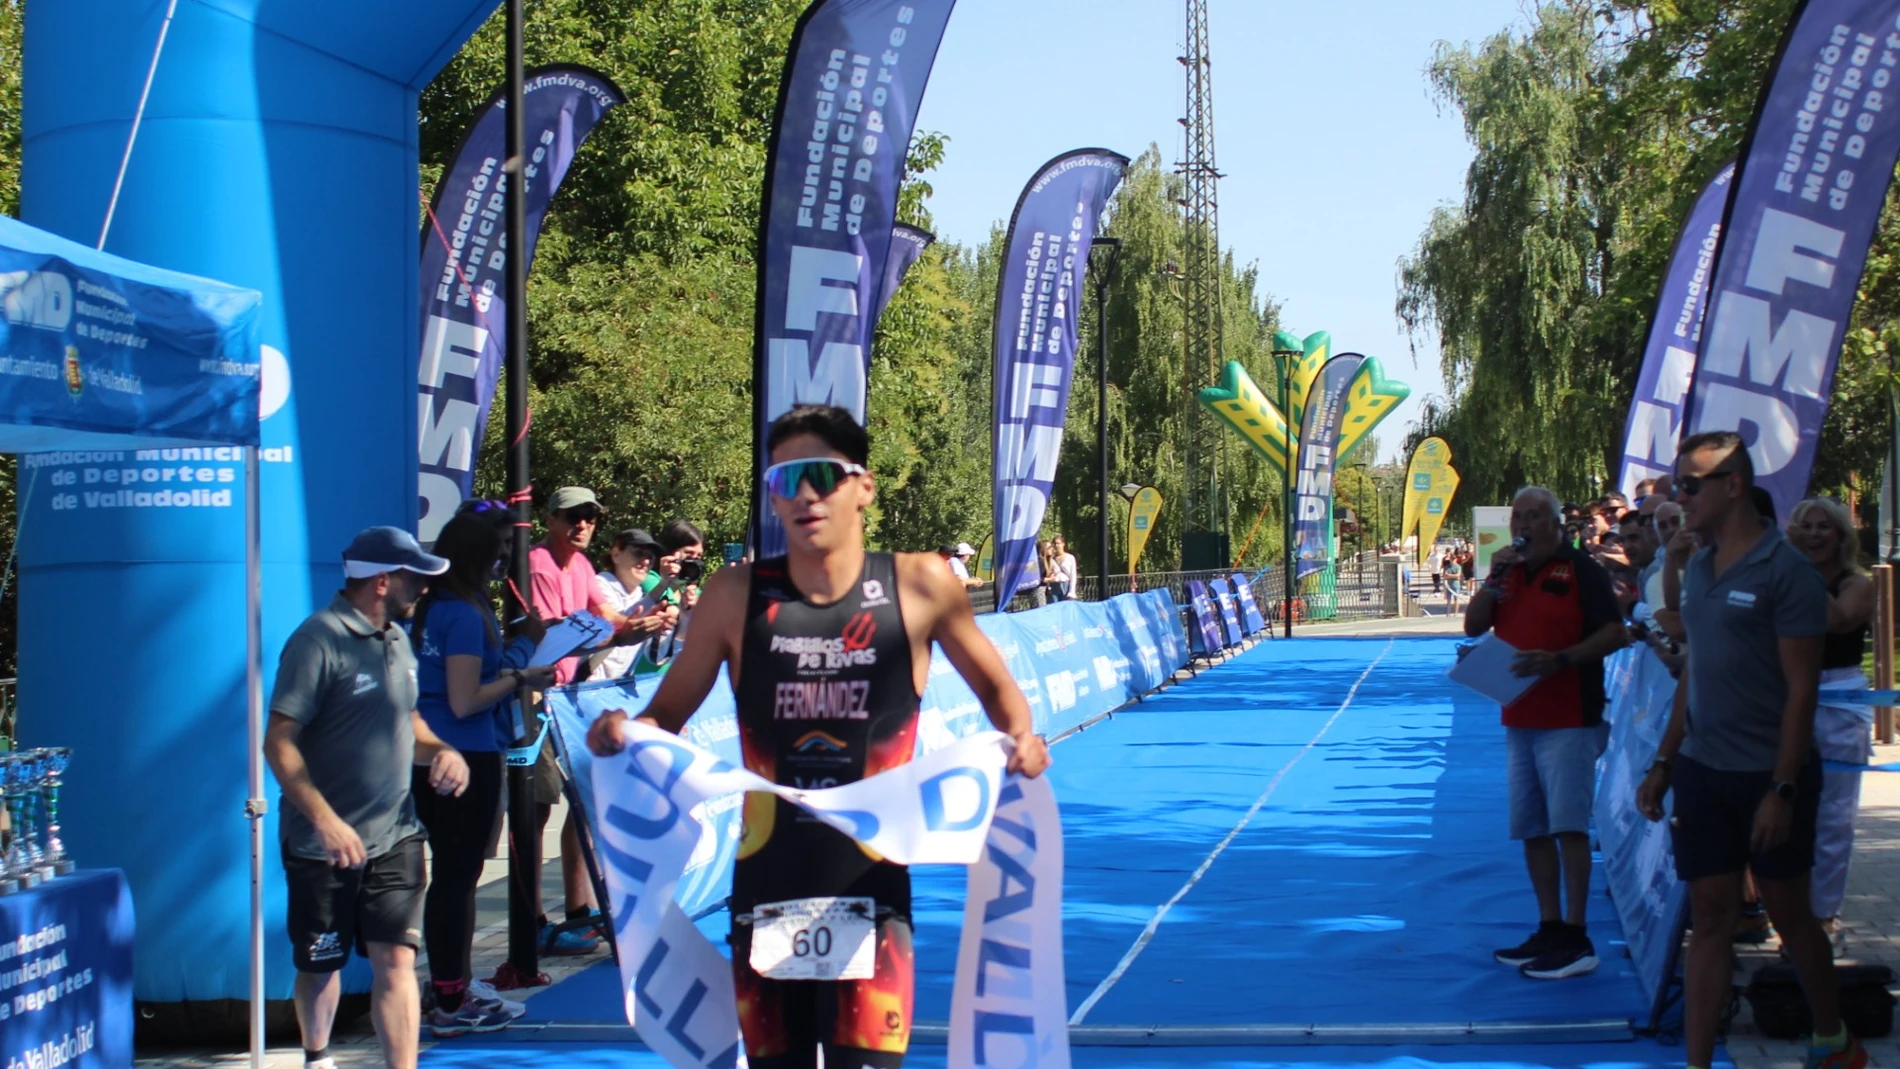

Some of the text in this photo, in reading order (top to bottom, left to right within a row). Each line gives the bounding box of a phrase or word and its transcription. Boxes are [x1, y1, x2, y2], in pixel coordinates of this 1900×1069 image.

[797, 49, 846, 228] Fundación
[821, 55, 871, 232] Municipal
[846, 6, 914, 236] de Deportes
[1775, 24, 1850, 193] Fundación
[1801, 33, 1876, 202] Municipal
[1829, 12, 1900, 211] de Deport
[1032, 157, 1122, 194] www.fmdva.org
[436, 157, 497, 302] Fundación
[477, 279, 496, 313] de
[1016, 231, 1046, 351] Fundación
[1031, 234, 1063, 353] Municipal
[1673, 223, 1722, 338] Fundación
[767, 245, 866, 428] FM
[1048, 325, 1062, 355] de
[51, 466, 236, 486] de Deportes
[51, 489, 233, 511] de Valladolid
[136, 446, 293, 462] Municial
[1000, 362, 1063, 543] FMD
[1298, 444, 1332, 521] FMD
[773, 677, 871, 719] FERNÁNDEZ
[0, 921, 67, 962] undación
[0, 948, 68, 992] unicipal
[793, 926, 832, 957] 60
[14, 967, 94, 1016] Deportes
